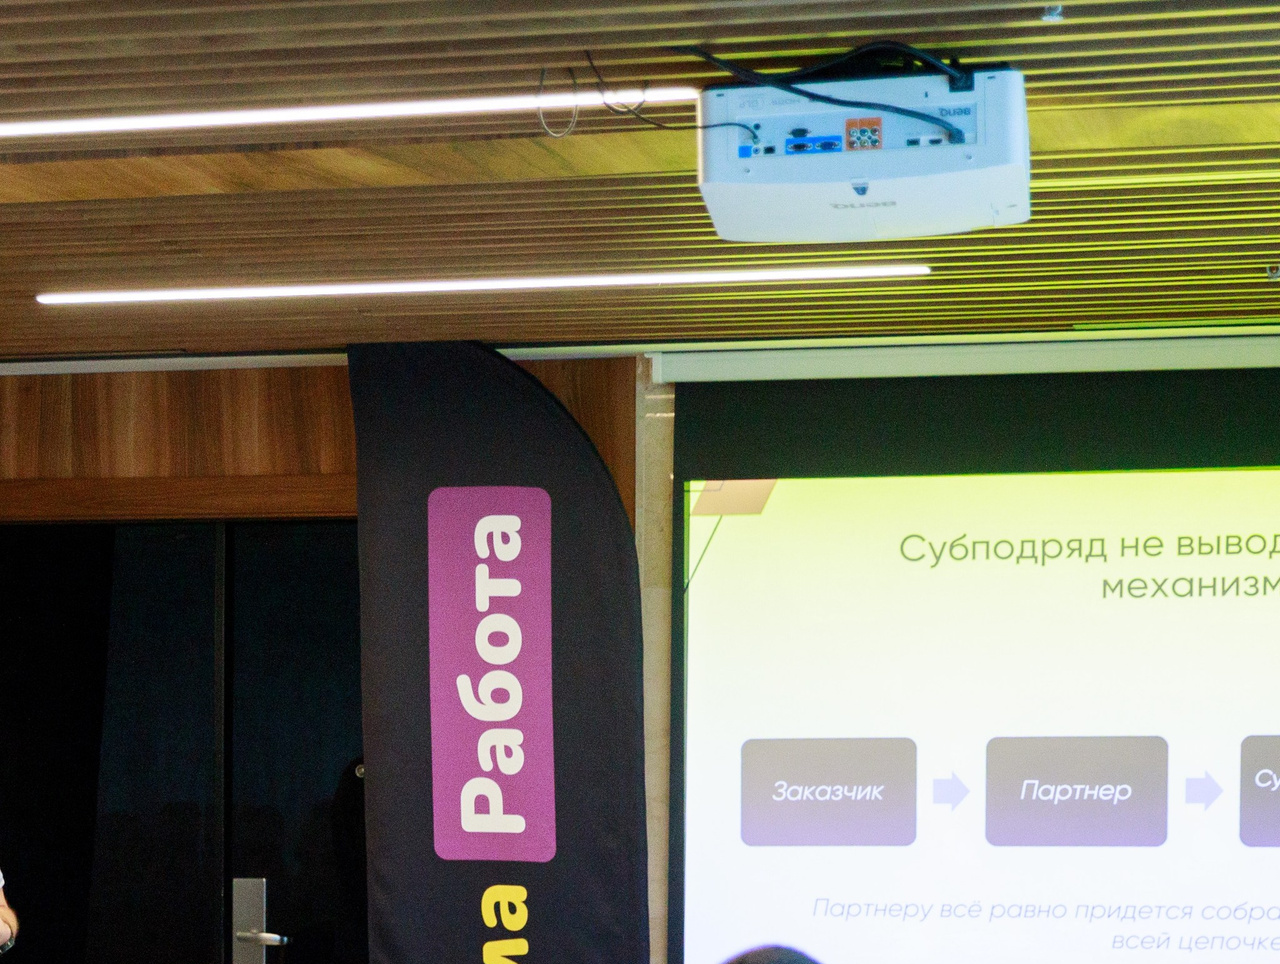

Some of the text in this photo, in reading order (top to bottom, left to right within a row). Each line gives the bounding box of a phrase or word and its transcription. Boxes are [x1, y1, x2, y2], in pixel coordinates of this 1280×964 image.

[900, 533, 1108, 568] Субподряд
[1120, 536, 1165, 558] не
[1102, 575, 1280, 599] механизм
[455, 514, 527, 834] Работа
[771, 780, 885, 801] Заказчик
[1020, 779, 1133, 805] Партнер
[813, 897, 934, 923] Партнеру
[940, 901, 982, 919] всё
[988, 903, 1068, 922] равно
[1074, 904, 1194, 923] придется
[1112, 932, 1171, 950] всей
